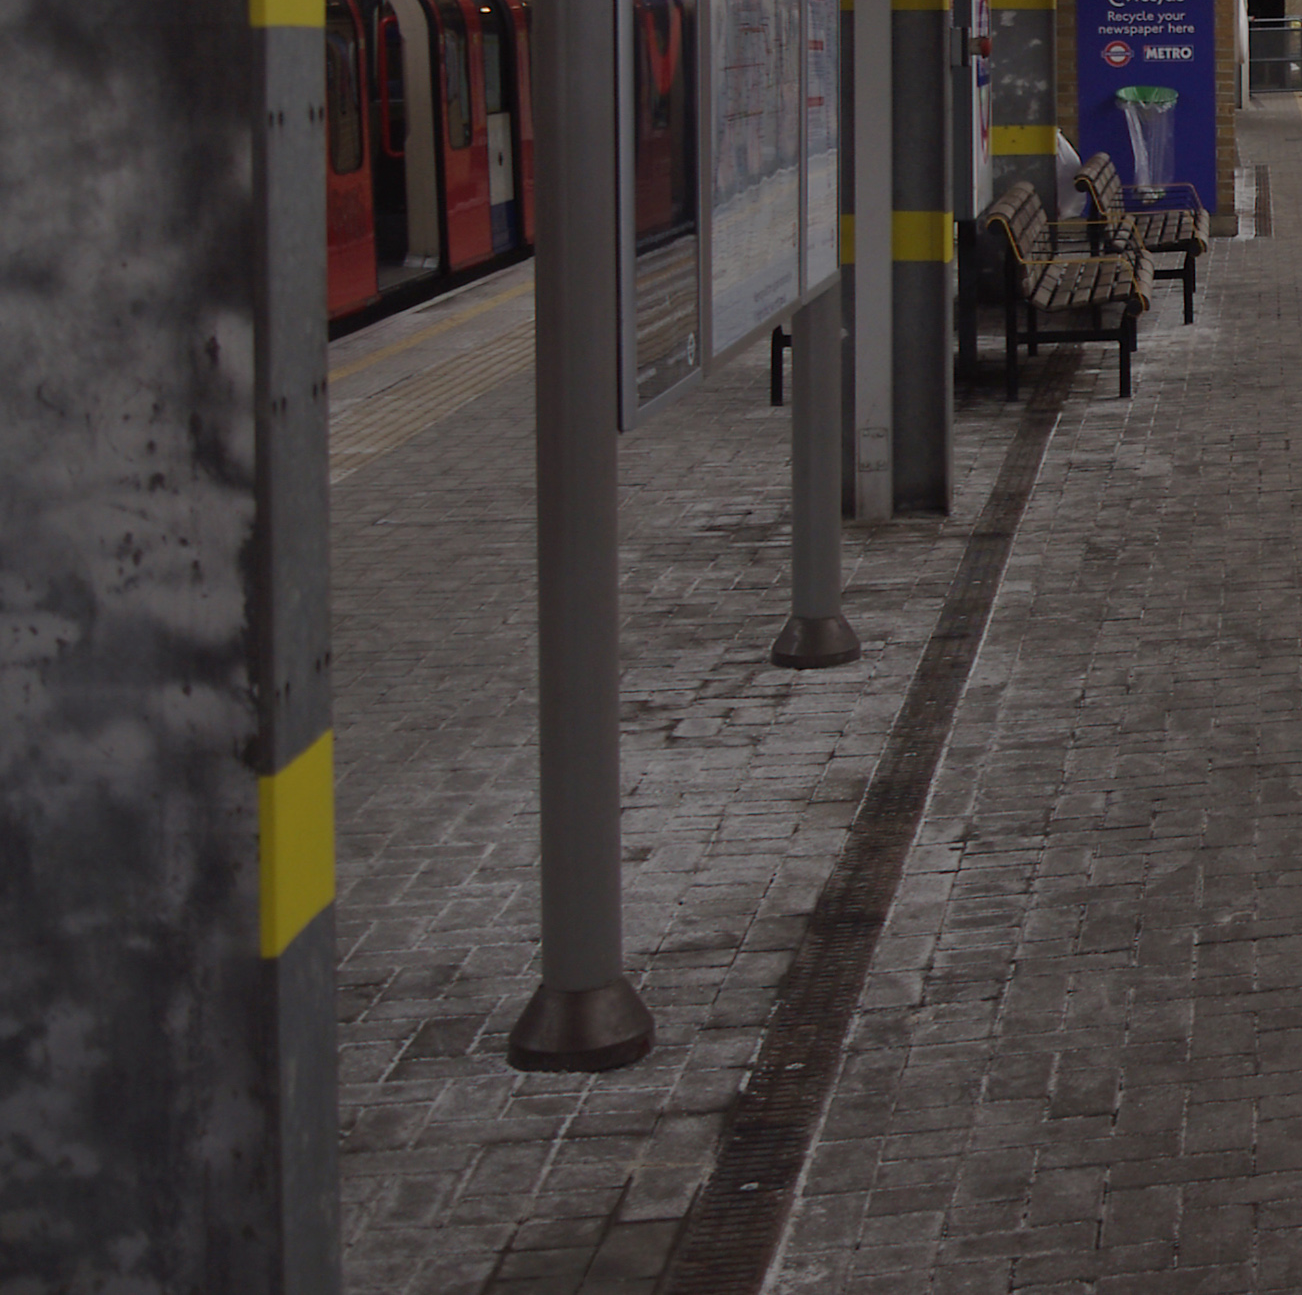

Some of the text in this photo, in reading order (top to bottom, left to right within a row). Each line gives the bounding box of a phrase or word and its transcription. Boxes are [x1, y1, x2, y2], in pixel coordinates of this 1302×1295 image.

[1107, 11, 1186, 25] Recycle your
[1098, 22, 1195, 37] newspaper here
[1145, 46, 1193, 60] METRO
